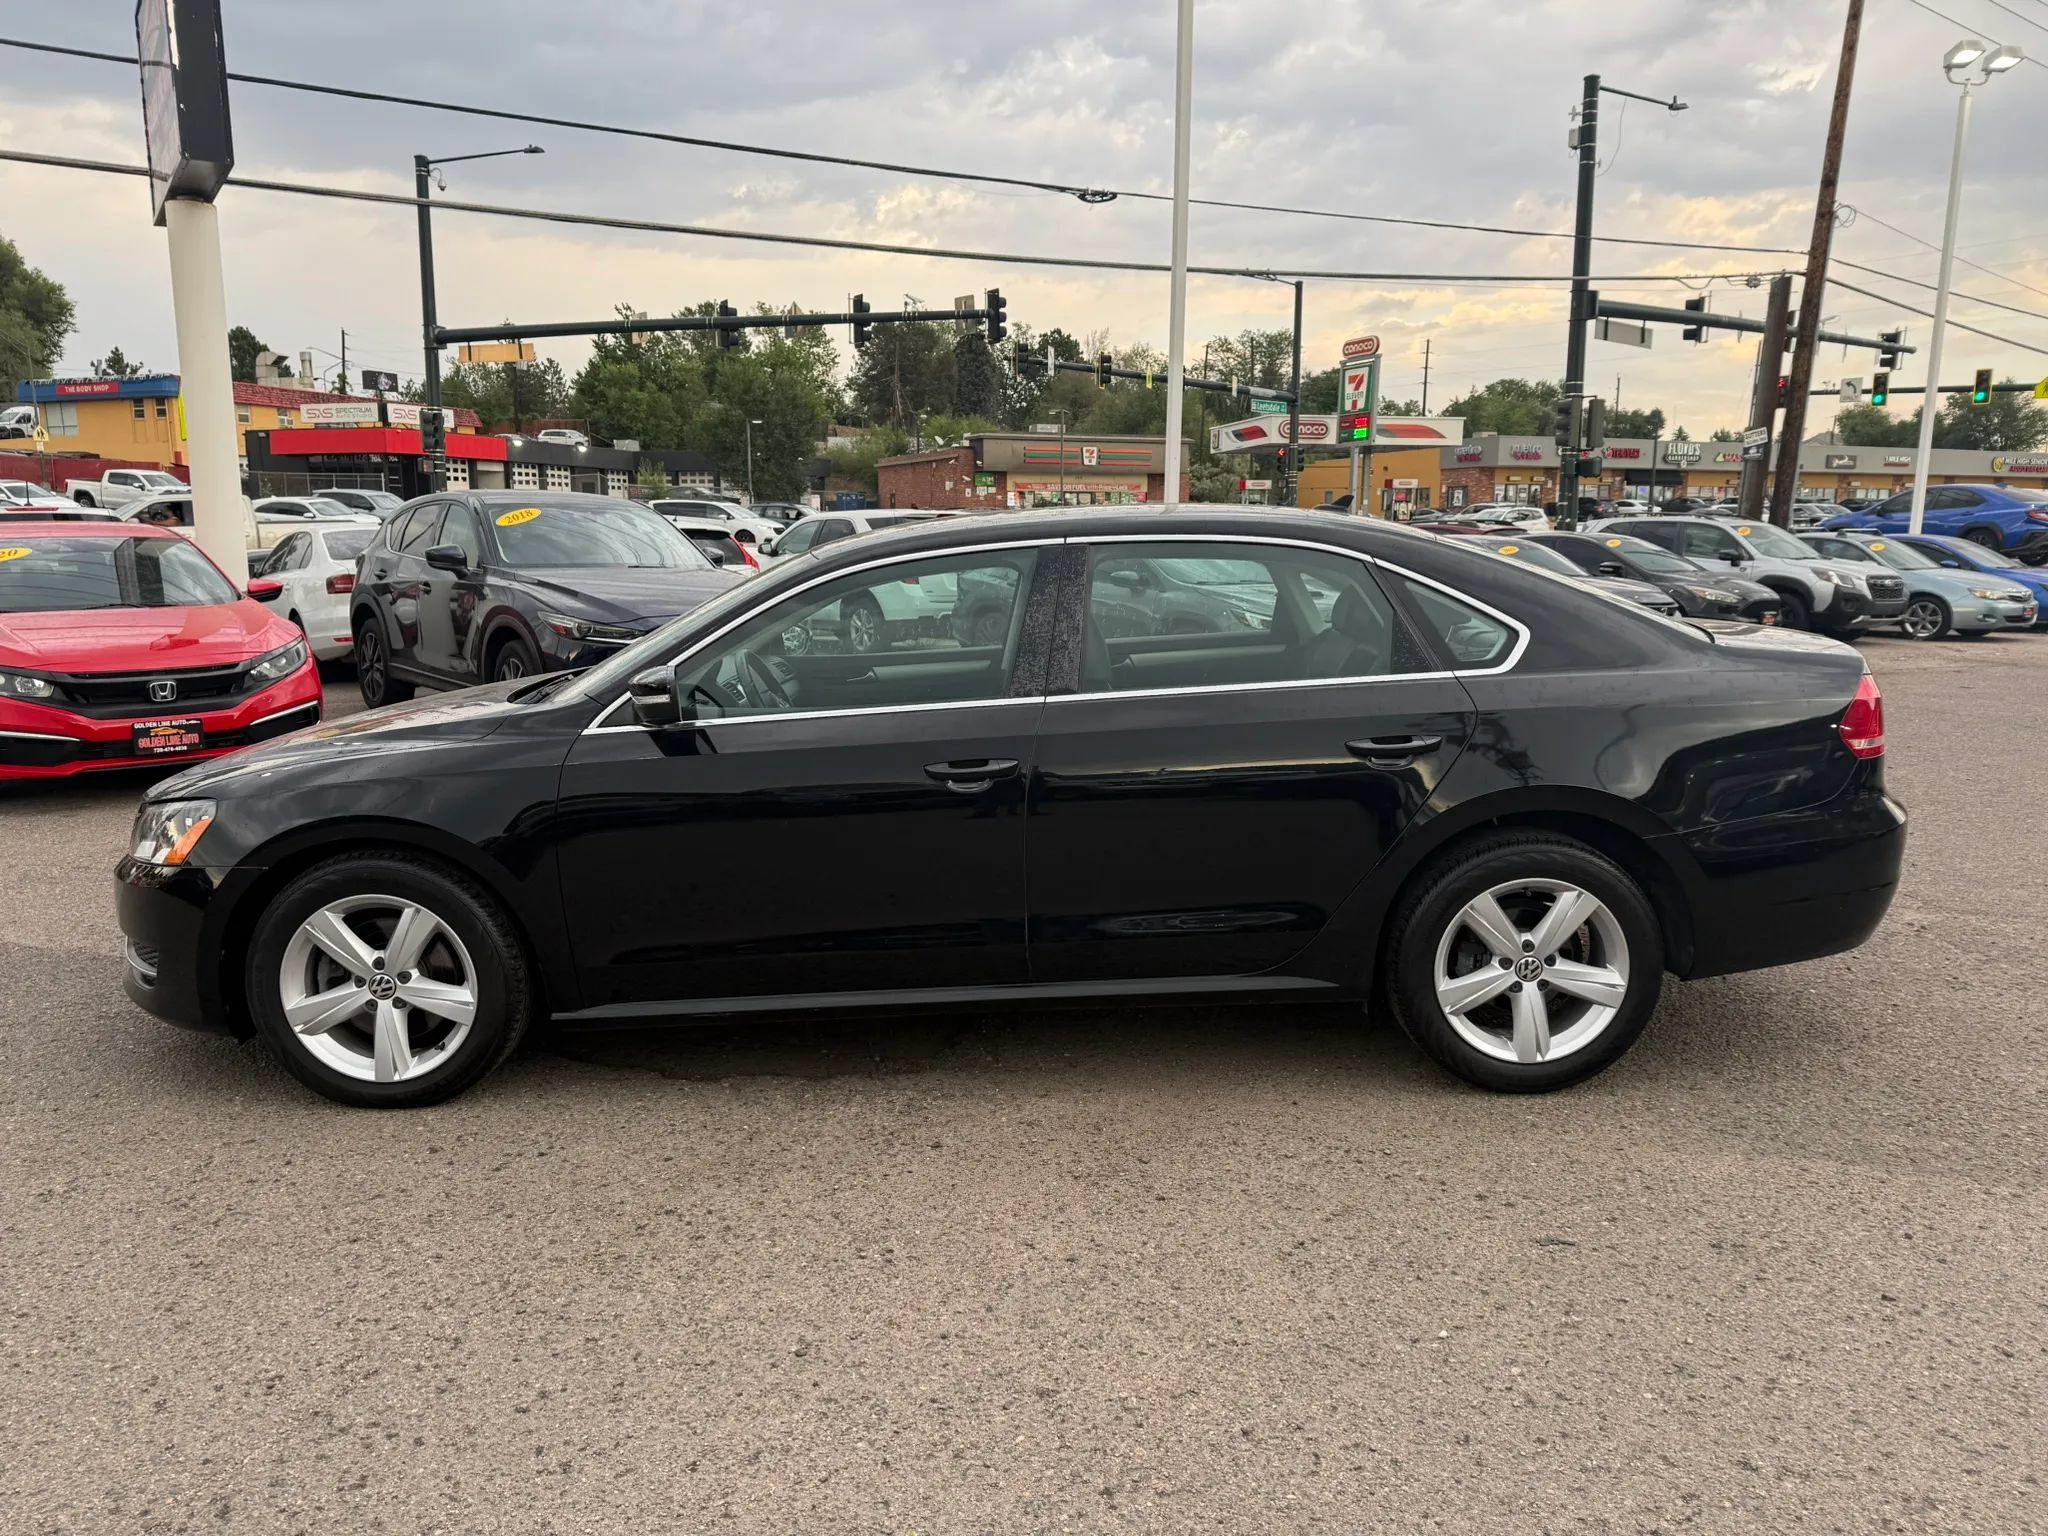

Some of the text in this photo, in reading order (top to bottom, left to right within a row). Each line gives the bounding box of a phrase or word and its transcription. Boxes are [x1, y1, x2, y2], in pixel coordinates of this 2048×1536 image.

[76, 385, 91, 393] BODY
[93, 384, 109, 392] SHOP
[1347, 373, 1365, 391] 7
[1668, 442, 1701, 455] FLOYD'S
[504, 509, 534, 524] 2018
[134, 721, 157, 729] GOLDEN
[138, 732, 199, 748] GOLDEN LINE AUTO
